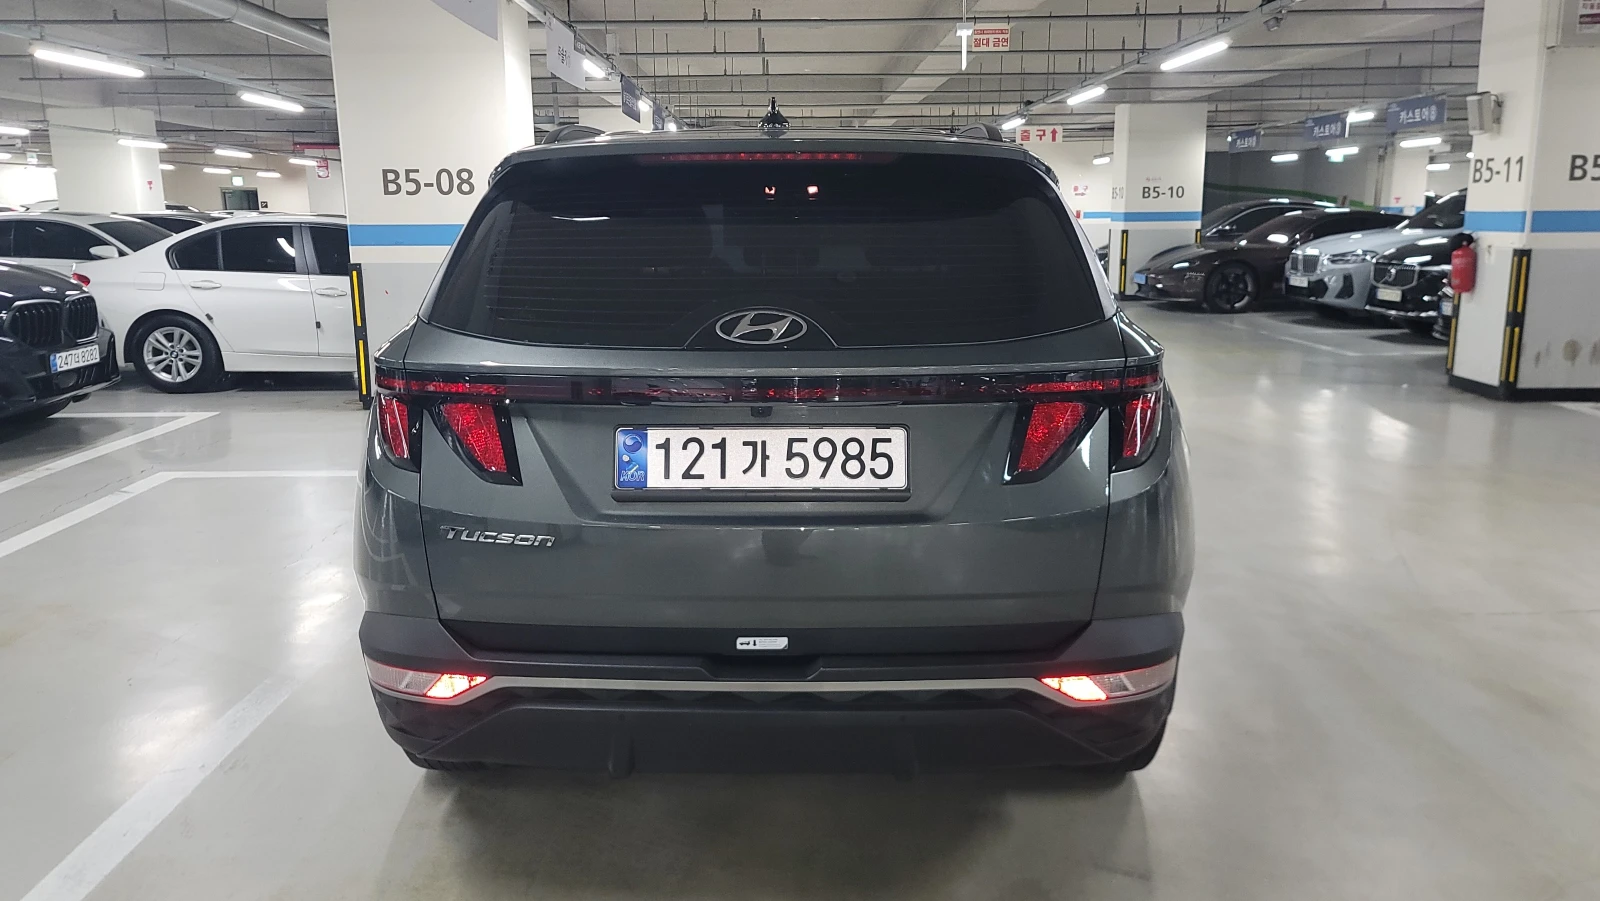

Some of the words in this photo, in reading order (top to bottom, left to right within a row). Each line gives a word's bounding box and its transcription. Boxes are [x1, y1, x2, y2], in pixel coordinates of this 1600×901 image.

[974, 37, 990, 48] 절대
[993, 37, 1009, 47] 금연
[1472, 156, 1524, 183] B5-11
[381, 167, 475, 196] B5-08
[1142, 185, 1185, 199] B5-10
[81, 347, 98, 363] 8282
[655, 437, 770, 480] 121가
[785, 436, 894, 480] 5985
[619, 469, 646, 483] KOR
